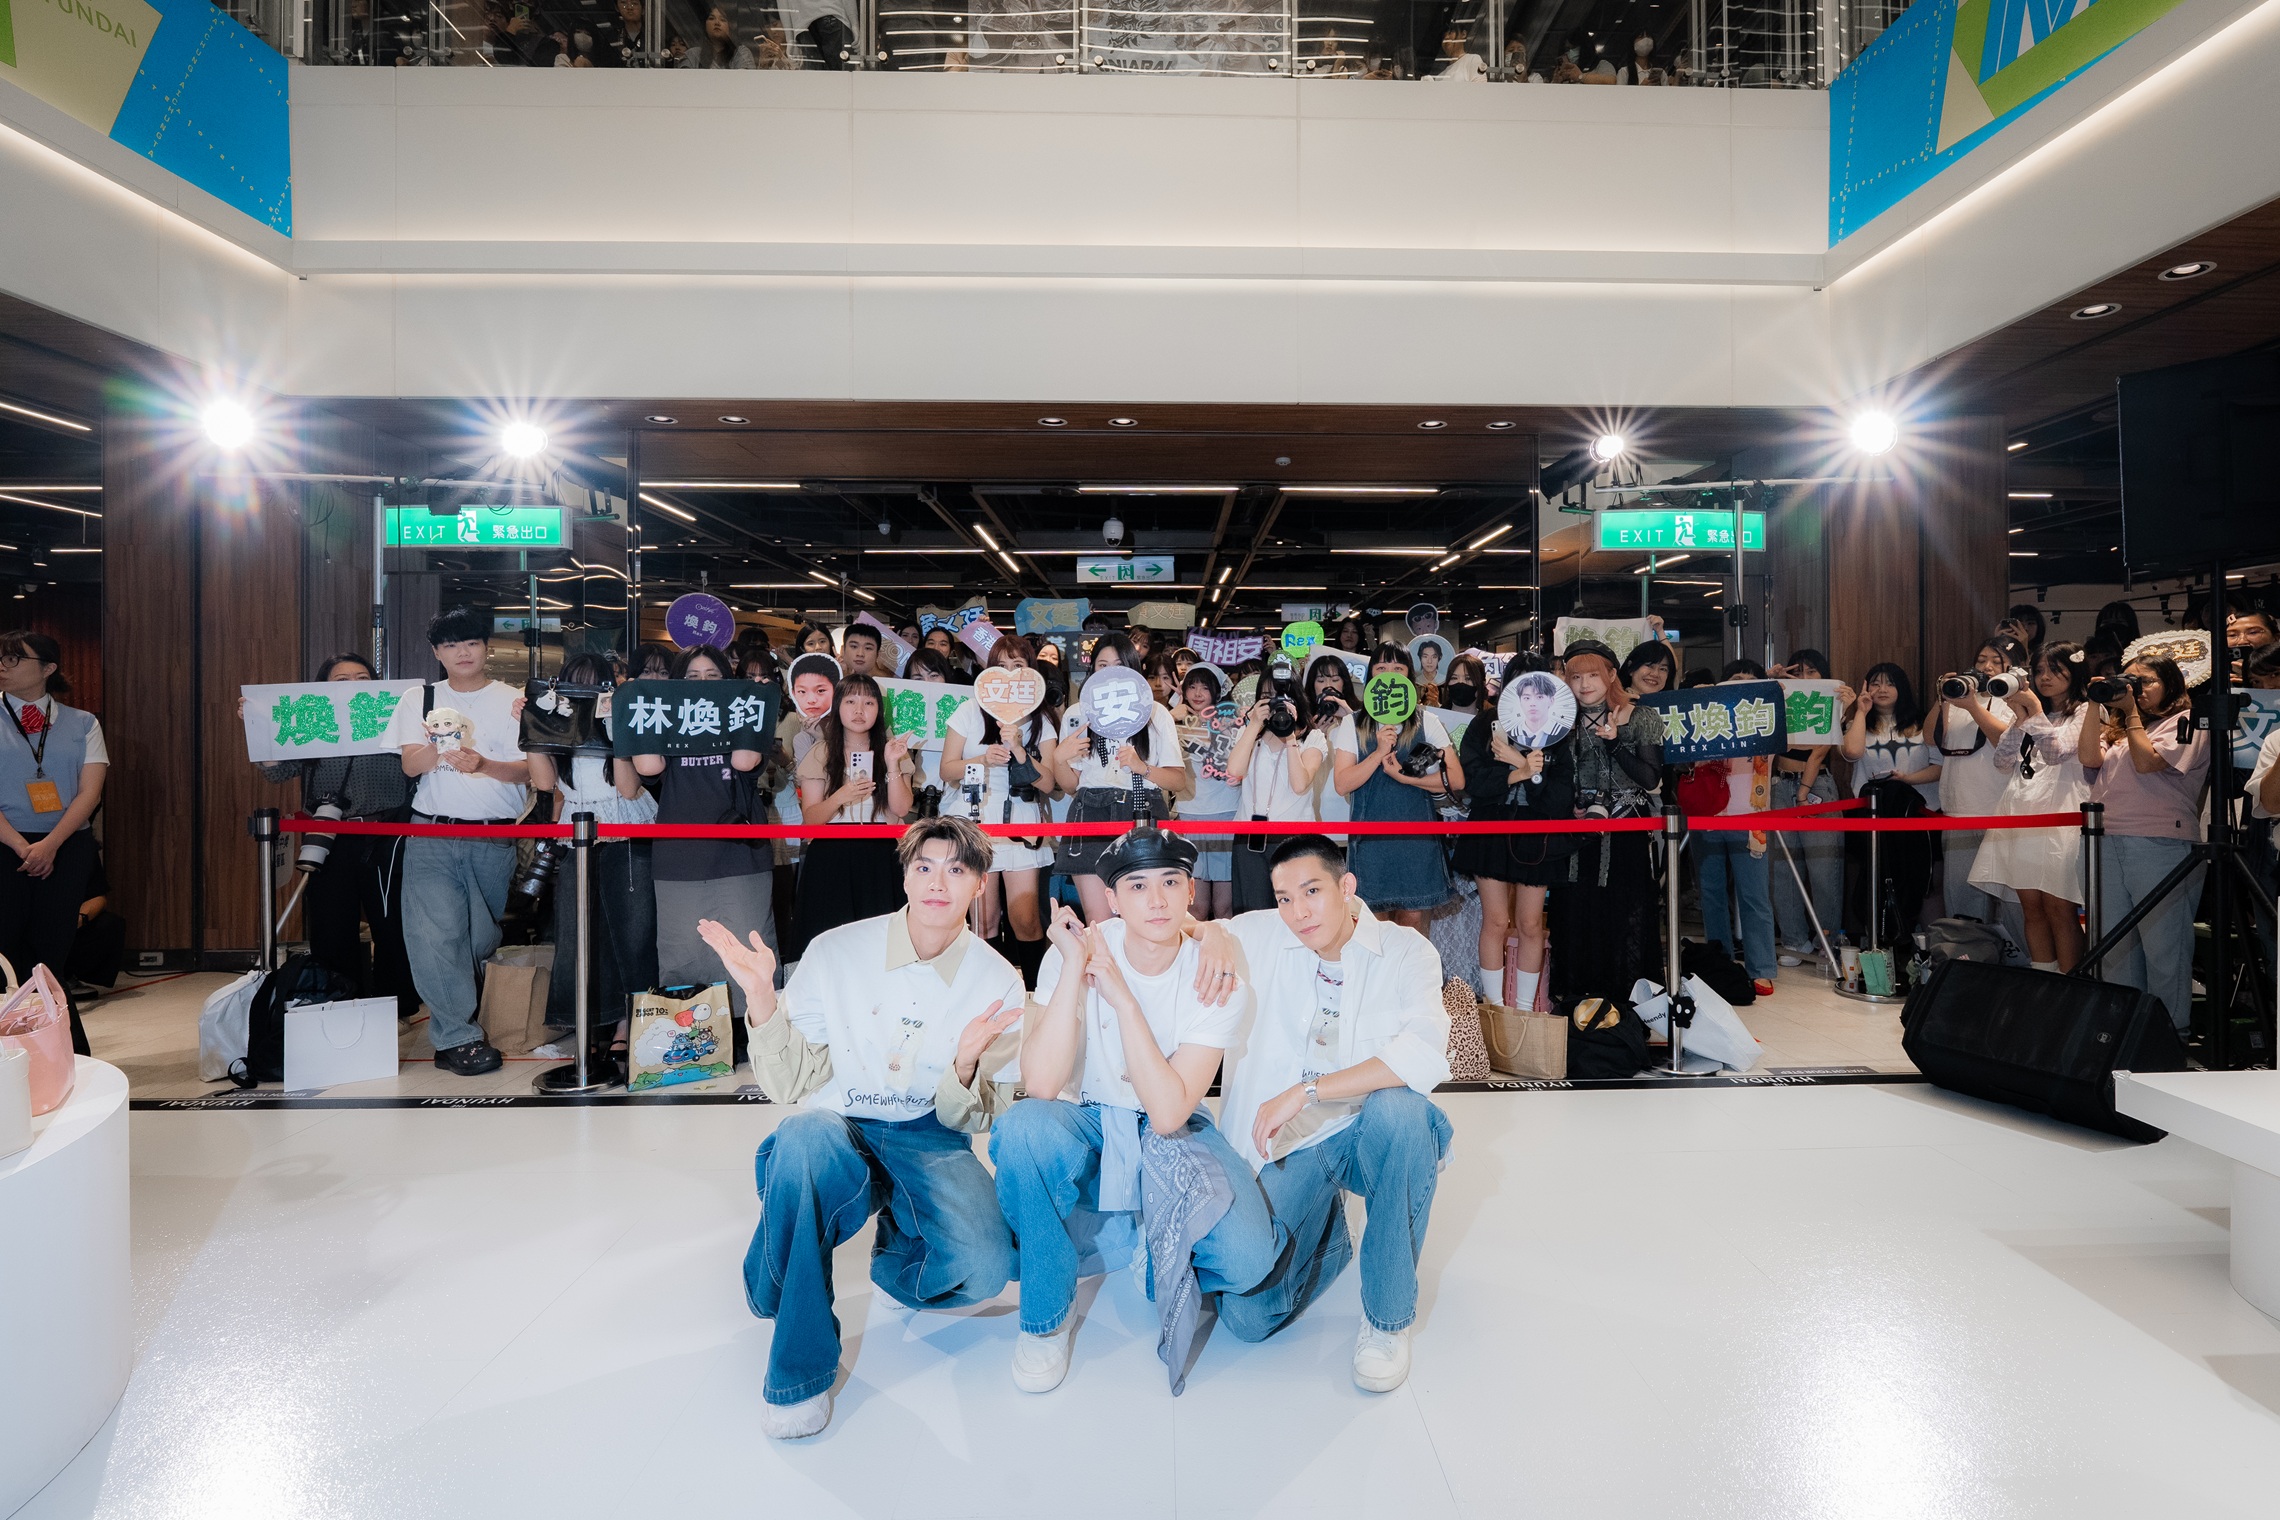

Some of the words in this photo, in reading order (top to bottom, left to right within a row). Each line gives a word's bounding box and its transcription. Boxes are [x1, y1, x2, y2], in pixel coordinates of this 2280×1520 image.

[403, 525, 446, 539] EXIT
[492, 524, 547, 539] 緊急出口
[1620, 530, 1664, 543] EXIT
[1026, 602, 1080, 629] 文廷
[1284, 633, 1316, 648] Rex
[1187, 634, 1264, 665] 周祖安
[983, 679, 1036, 704] 文廷
[1370, 678, 1410, 717] 鈞
[1092, 680, 1141, 727] 安
[628, 695, 766, 737] 林煥鈞
[1655, 697, 1777, 746] 林煥鈞
[712, 740, 731, 748] LIN
[680, 755, 725, 768] BUTTER
[721, 767, 732, 781] 2
[1487, 1081, 1574, 1089] HYUNDAI
[1730, 1076, 1816, 1084] HYUNDAI
[158, 1099, 256, 1107] HYUNDAI
[420, 1097, 515, 1105] HYUNDAI
